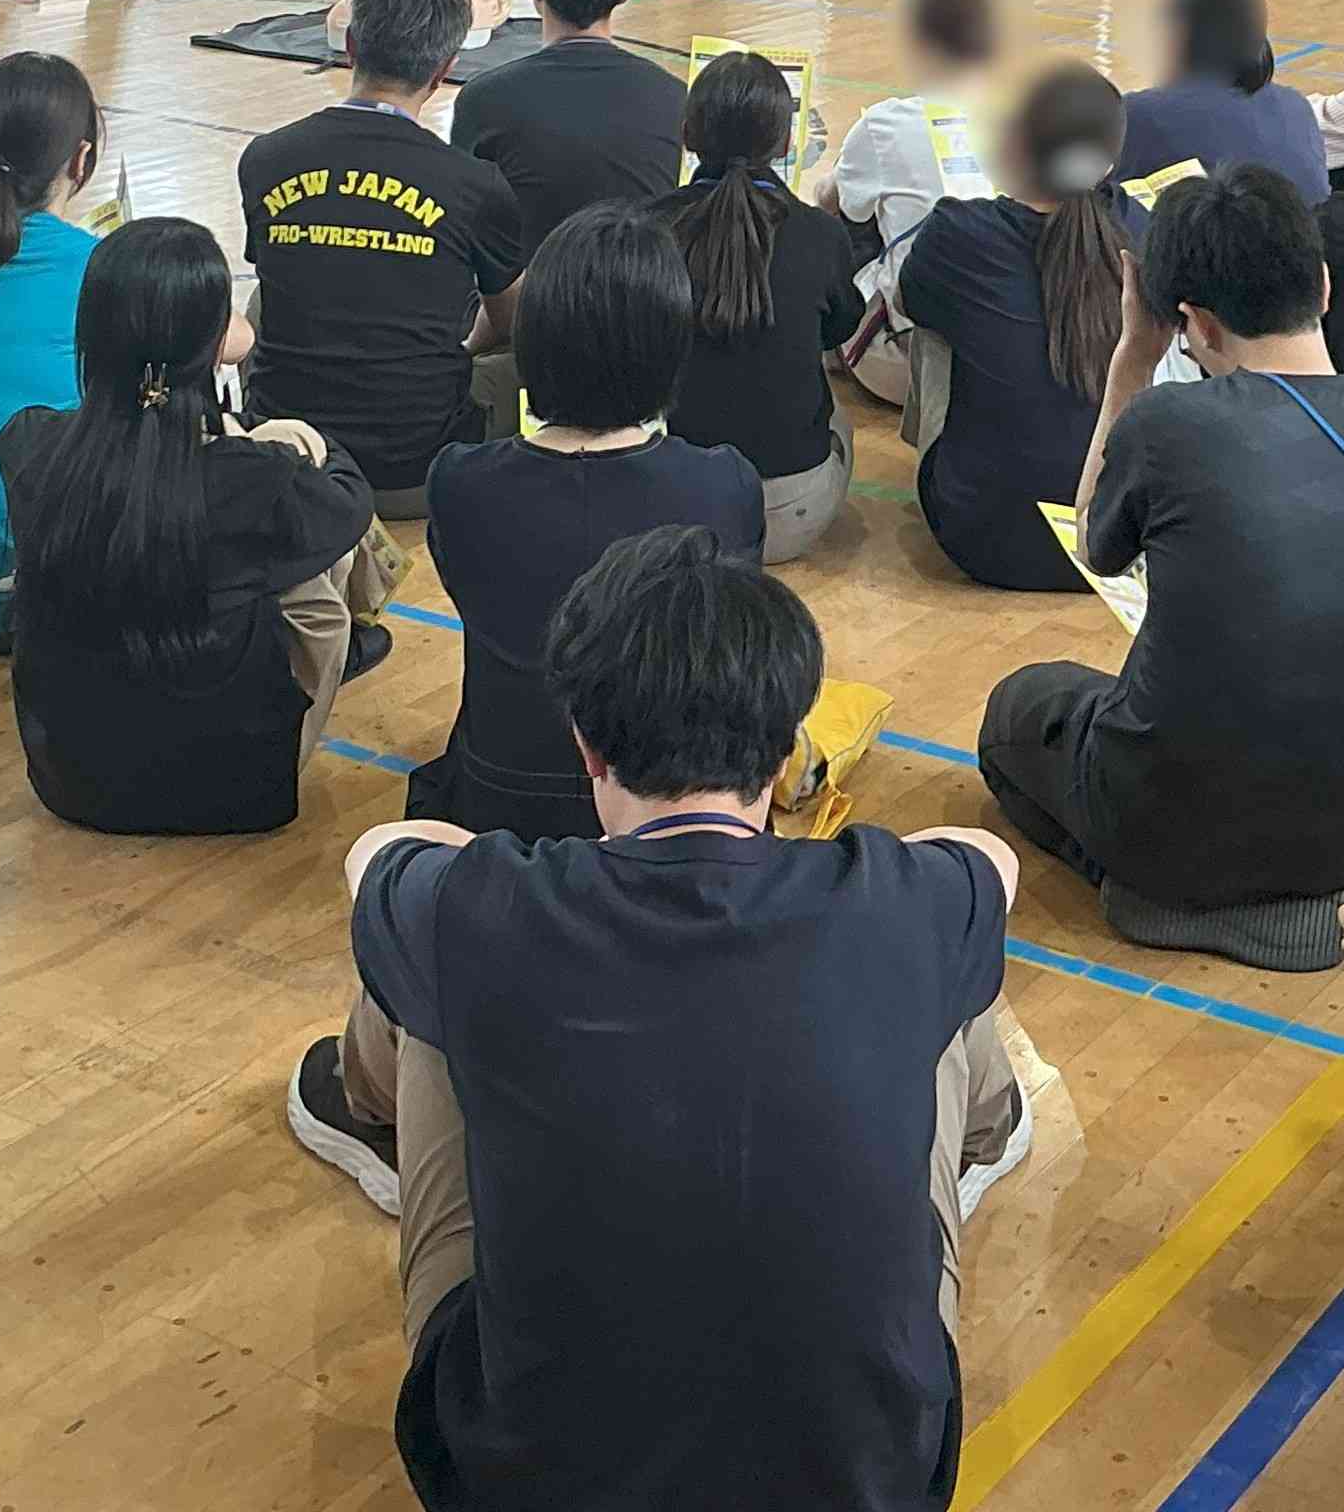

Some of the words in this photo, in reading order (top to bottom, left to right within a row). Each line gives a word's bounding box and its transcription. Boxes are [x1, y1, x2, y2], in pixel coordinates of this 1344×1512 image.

[262, 168, 330, 217] NEW
[339, 170, 446, 229] JAPAN
[268, 224, 436, 257] PRO-WRESTLING
